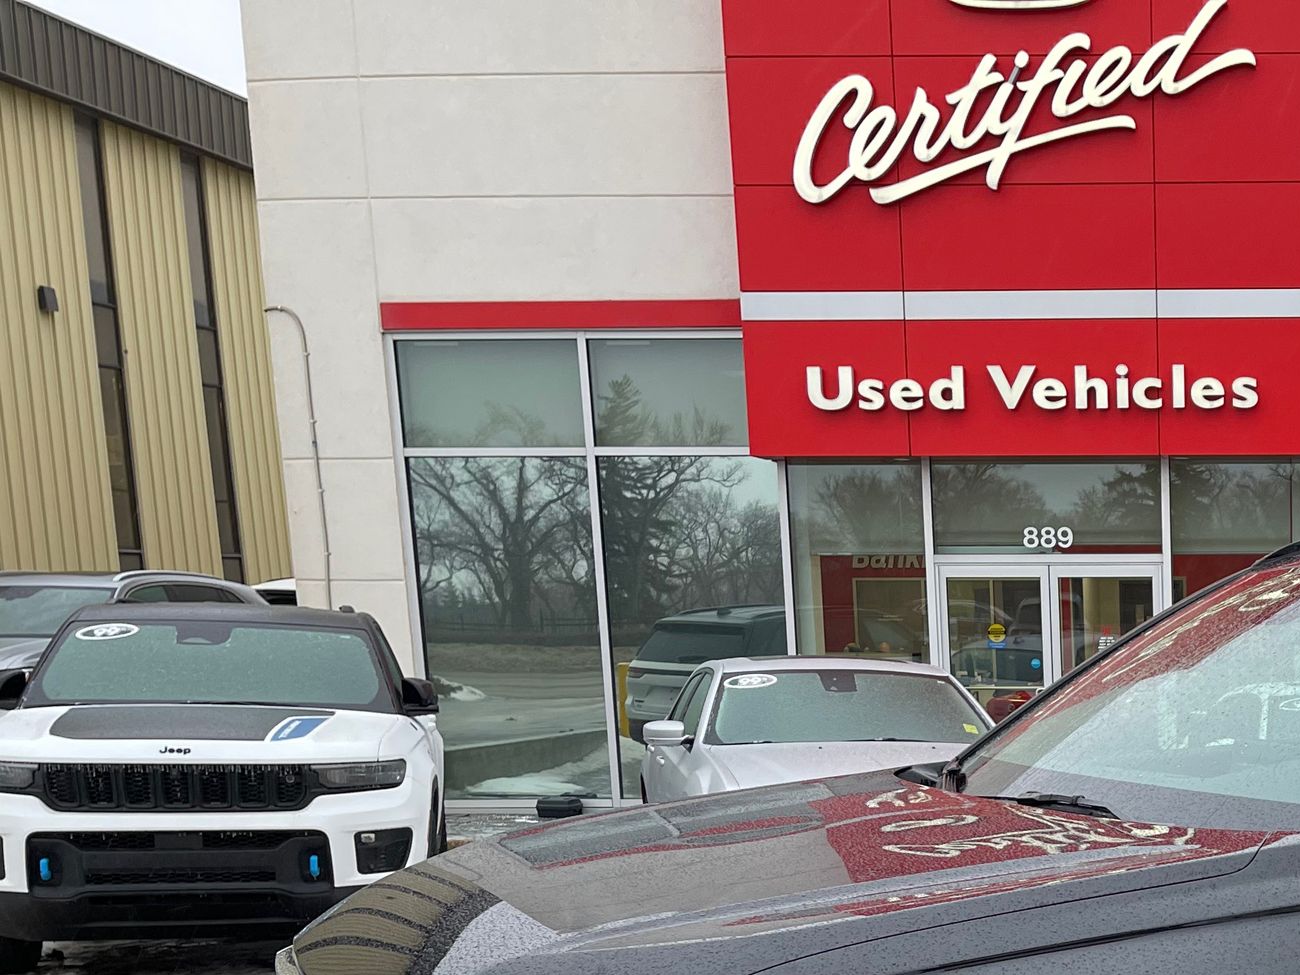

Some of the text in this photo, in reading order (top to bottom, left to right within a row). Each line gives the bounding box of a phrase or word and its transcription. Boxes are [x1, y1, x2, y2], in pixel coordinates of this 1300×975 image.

[792, 0, 1256, 204] Certified
[806, 364, 1260, 411] Used Vehicles
[1023, 526, 1073, 549] 889
[159, 746, 191, 755] Jeep
